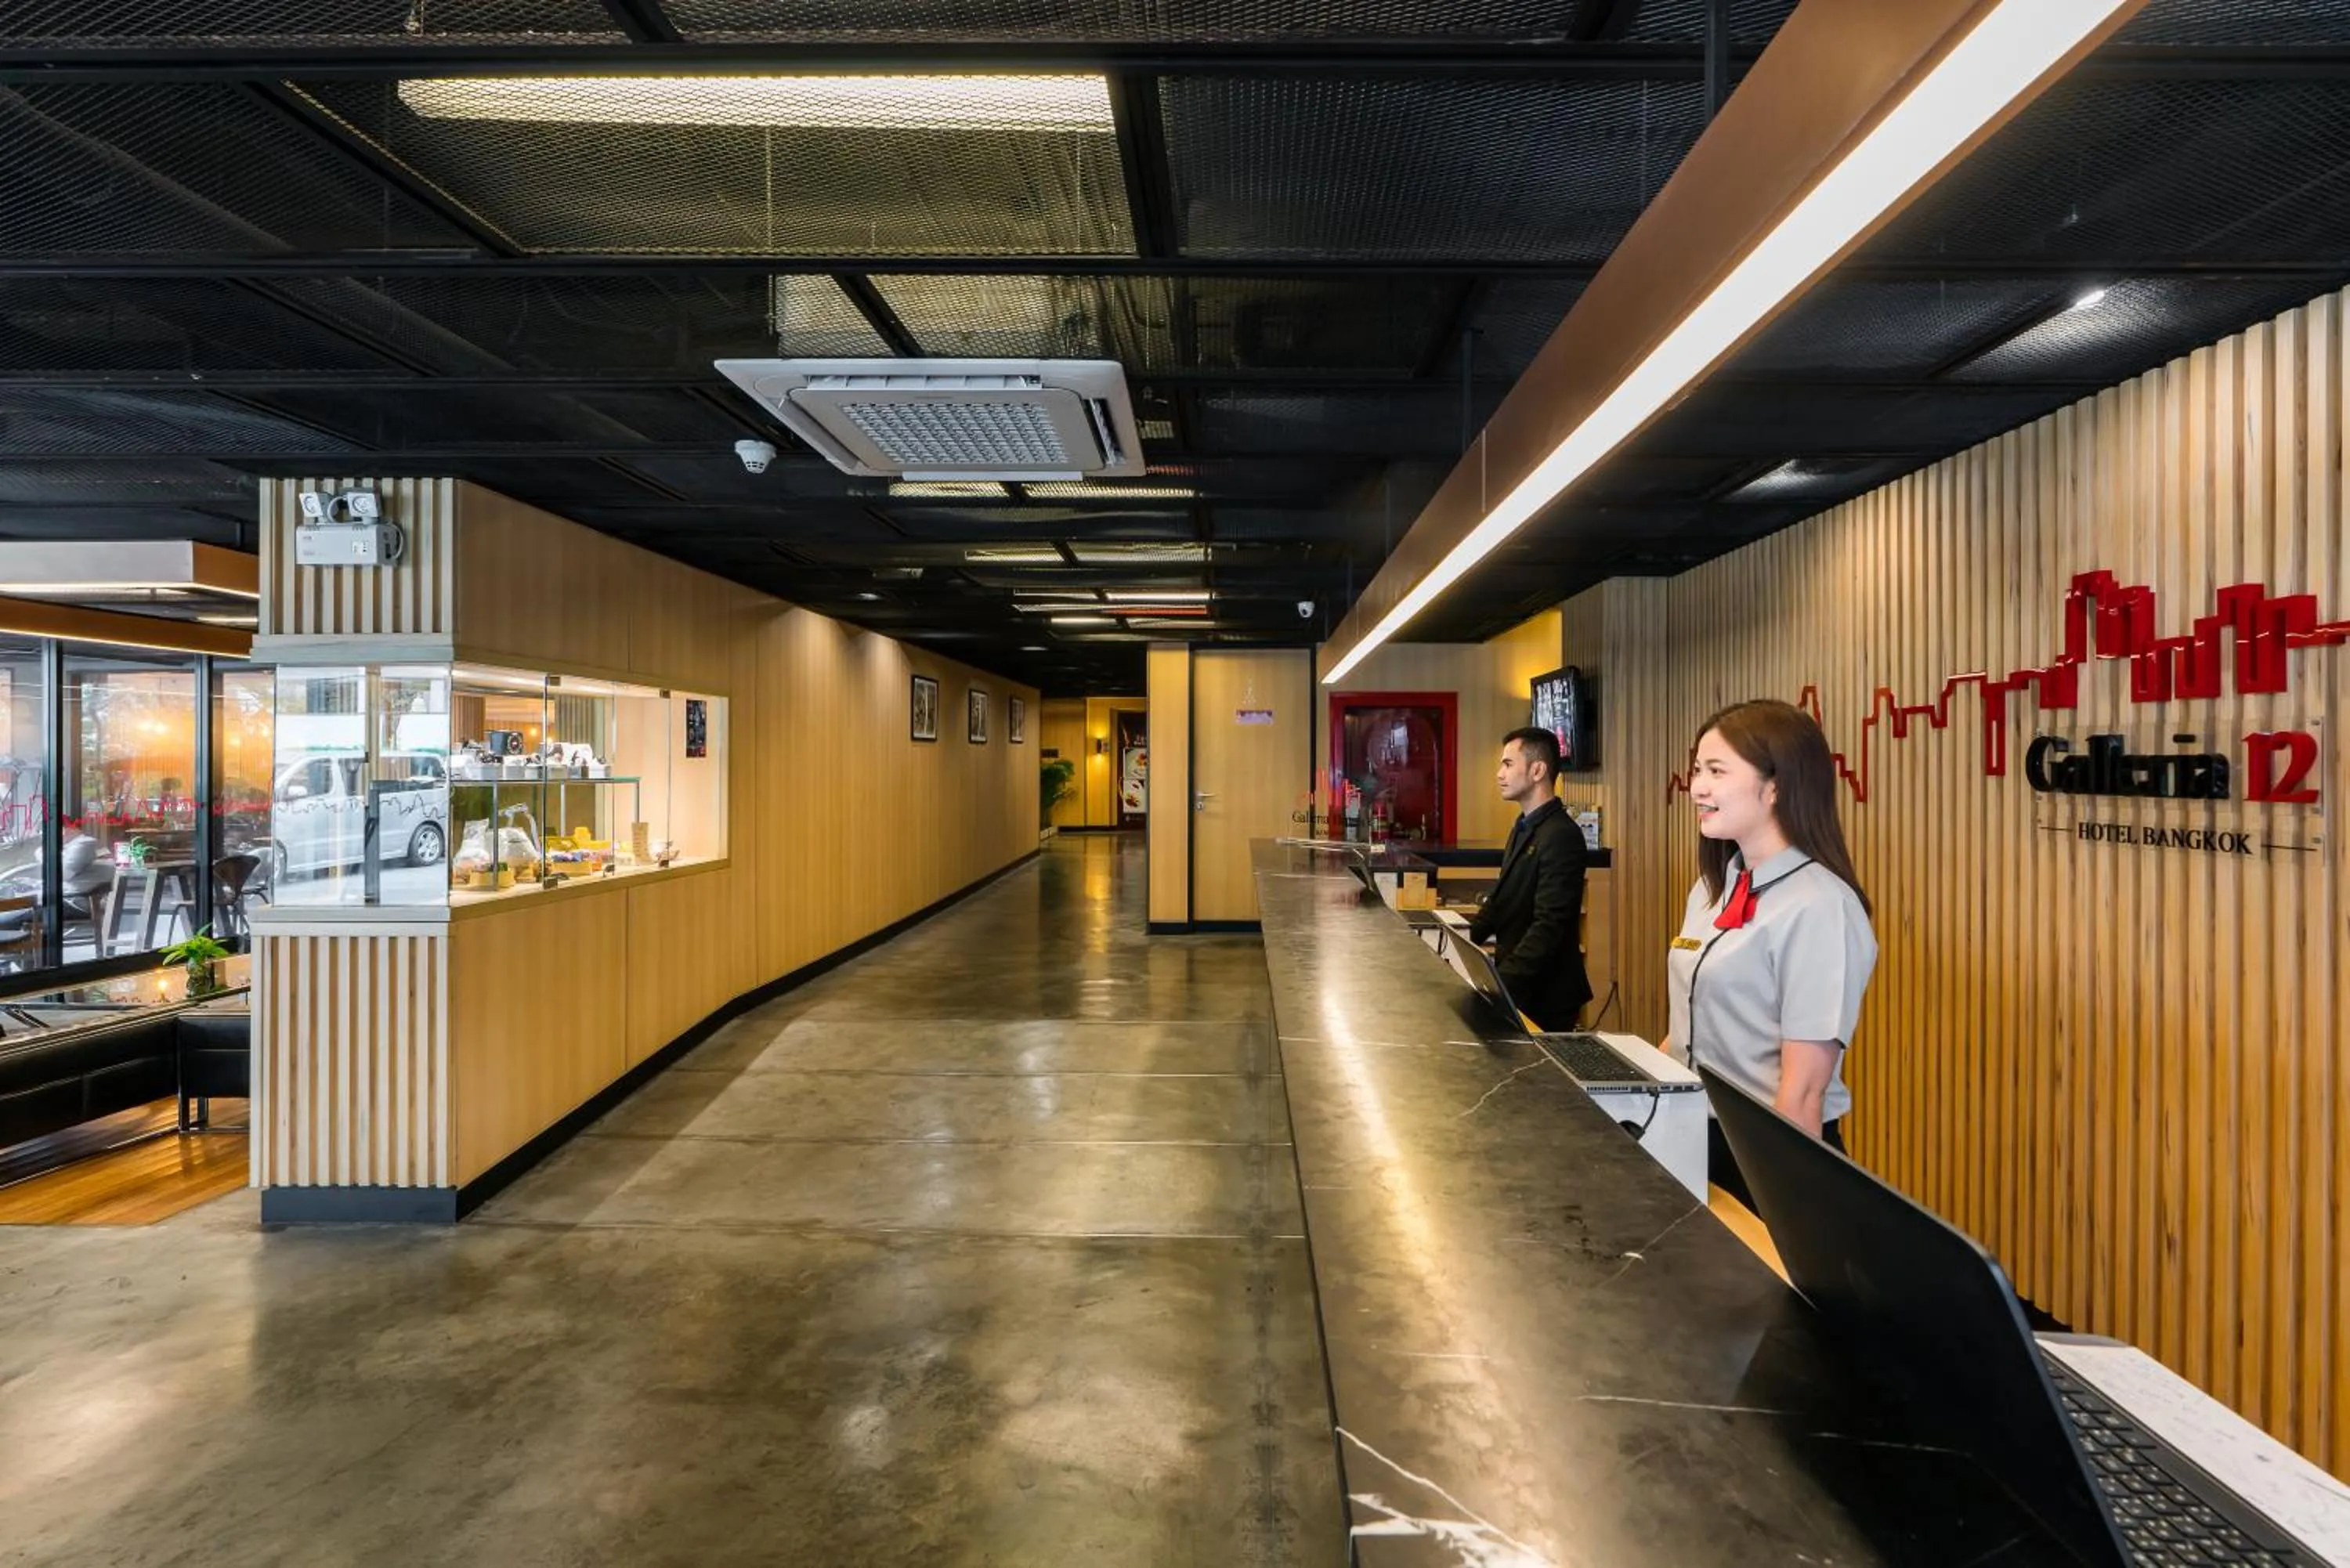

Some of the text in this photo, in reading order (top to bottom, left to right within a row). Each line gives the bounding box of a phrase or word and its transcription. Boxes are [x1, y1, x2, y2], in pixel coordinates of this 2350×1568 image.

[2026, 731, 2320, 803] Galleria 12
[2078, 822, 2253, 854] HOTEL BANGKOK
